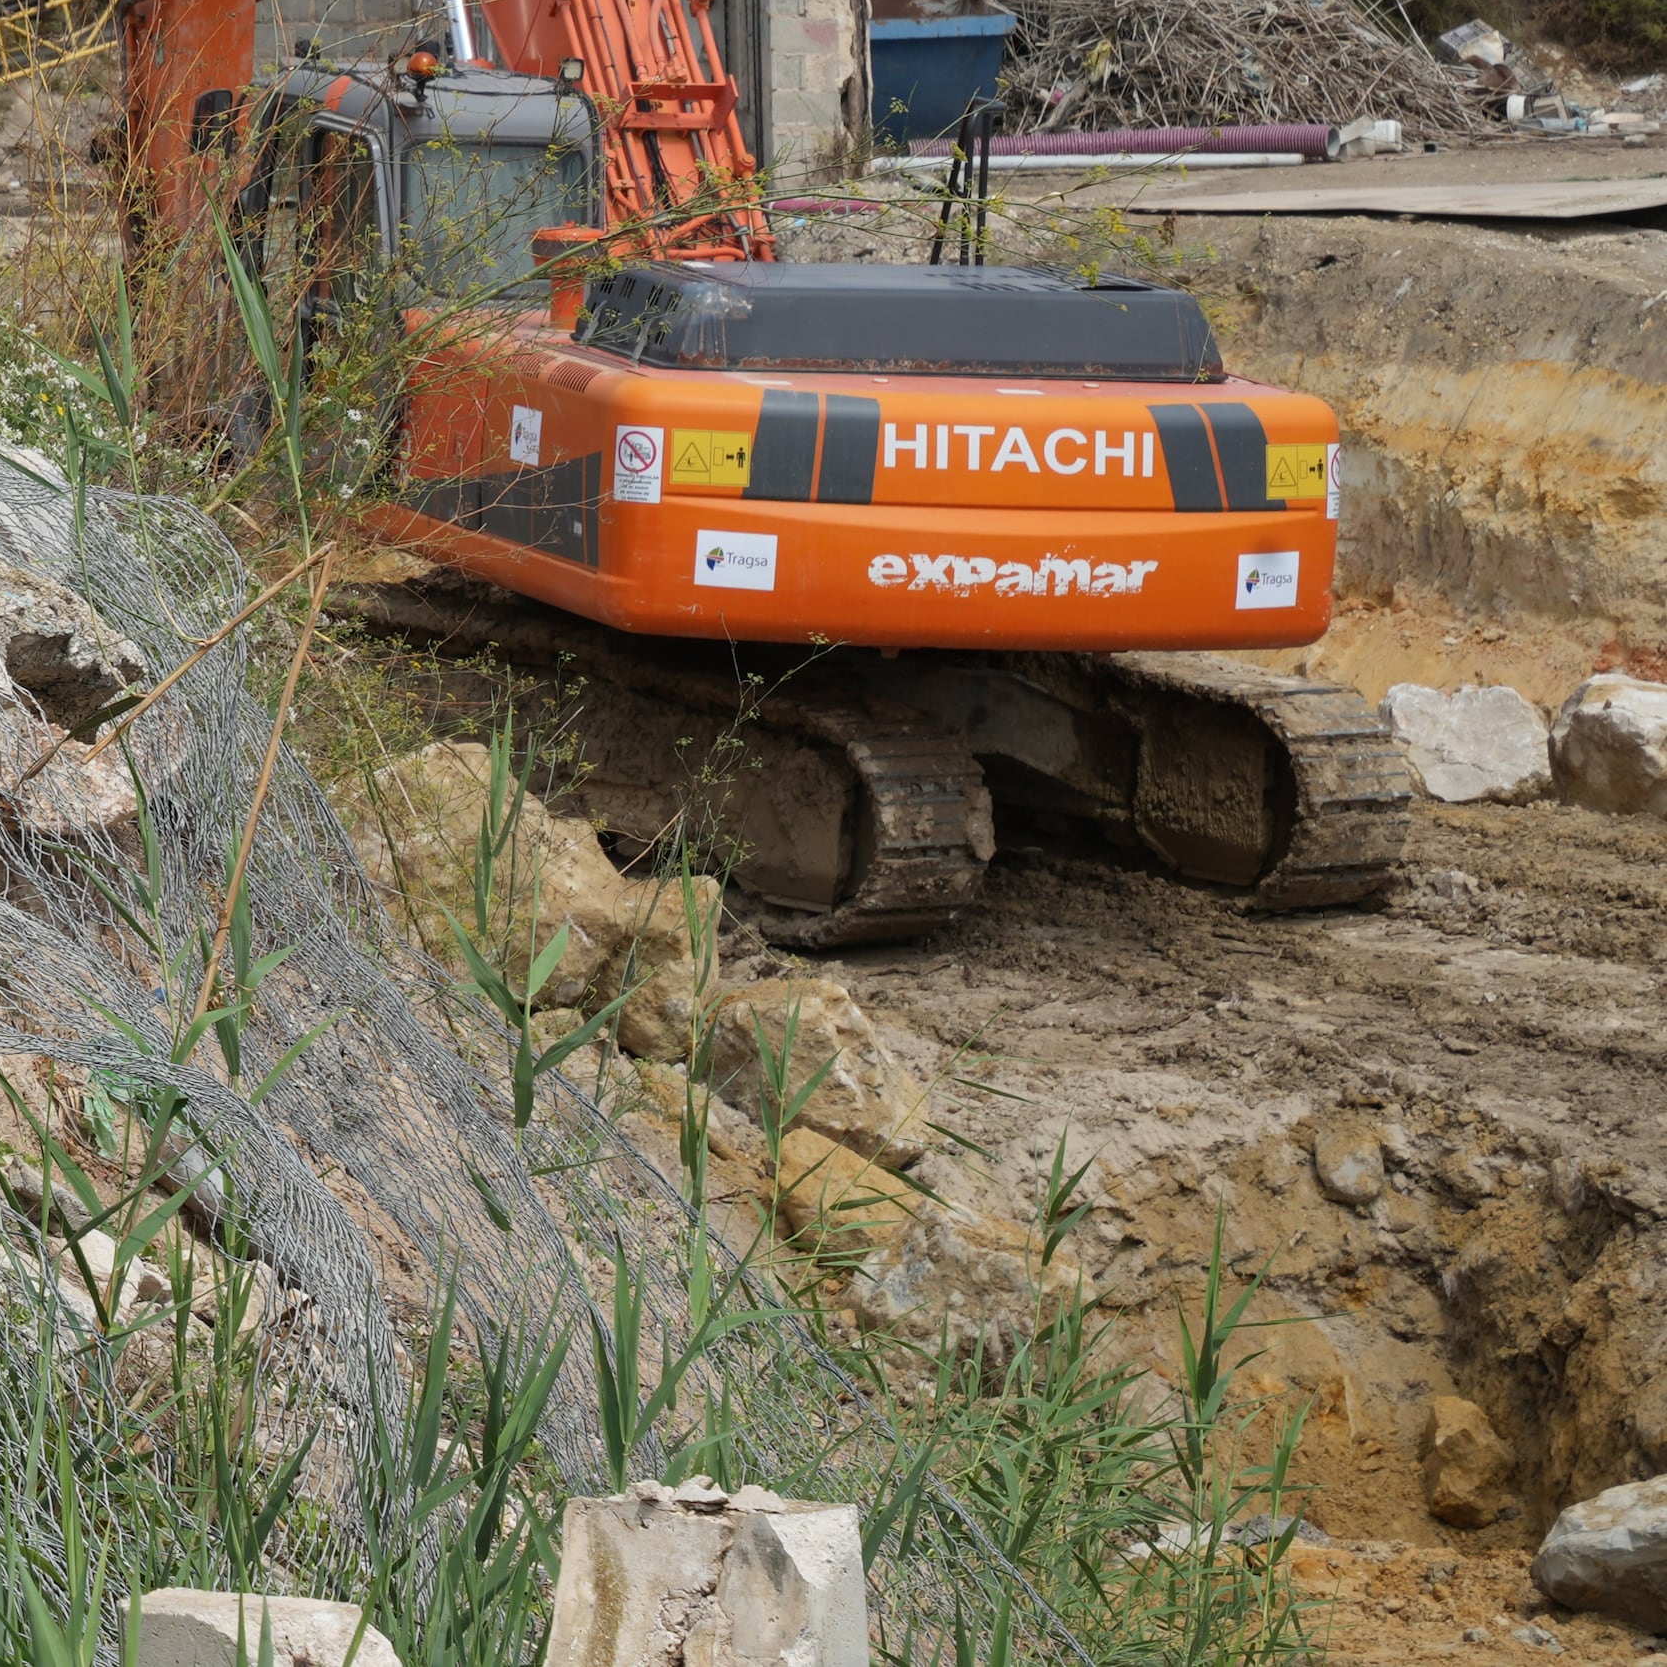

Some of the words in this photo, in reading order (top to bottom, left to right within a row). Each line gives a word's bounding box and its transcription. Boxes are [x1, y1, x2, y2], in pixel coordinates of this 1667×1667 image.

[883, 421, 1155, 478] HITACHI
[726, 551, 768, 569] Tragsa
[867, 553, 1159, 598] expamar
[1261, 572, 1293, 588] Tragsa
